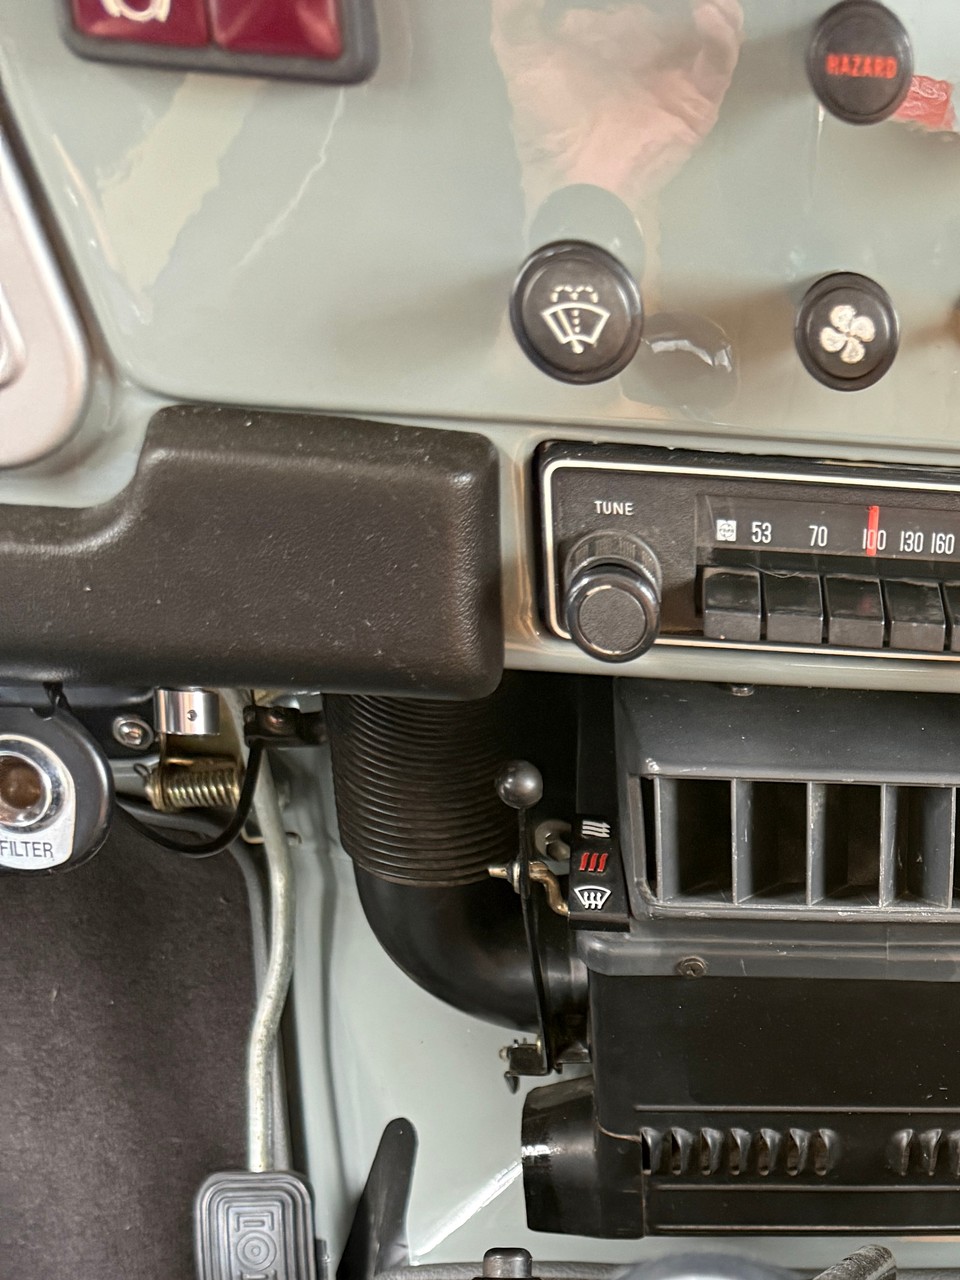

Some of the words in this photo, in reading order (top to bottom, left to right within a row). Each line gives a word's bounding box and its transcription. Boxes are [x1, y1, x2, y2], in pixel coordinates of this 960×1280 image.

[826, 54, 897, 79] HAZARD
[594, 500, 635, 516] TUNE
[751, 521, 773, 544] 53
[808, 525, 828, 547] 70
[862, 528, 887, 551] 100
[900, 530, 924, 553] 130
[931, 532, 955, 555] 160
[0, 840, 55, 858] FILTER
